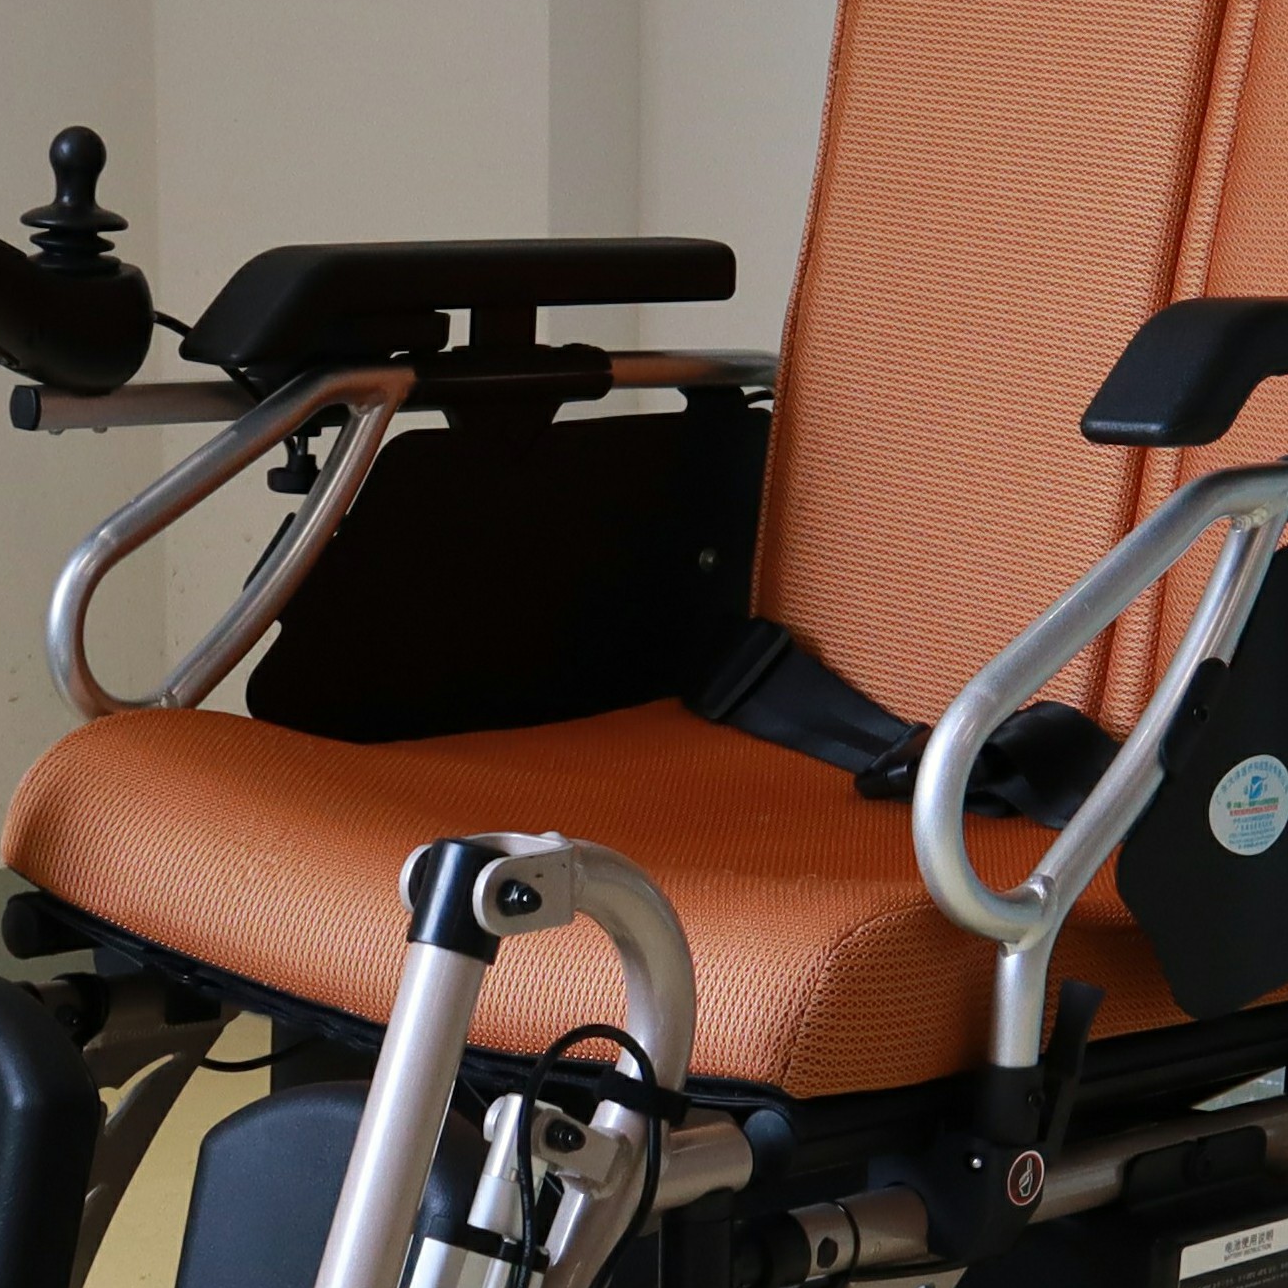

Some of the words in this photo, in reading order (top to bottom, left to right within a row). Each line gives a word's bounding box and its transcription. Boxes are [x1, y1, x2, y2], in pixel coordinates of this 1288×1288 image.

[1225, 1229, 1274, 1252] 电池使用说明
